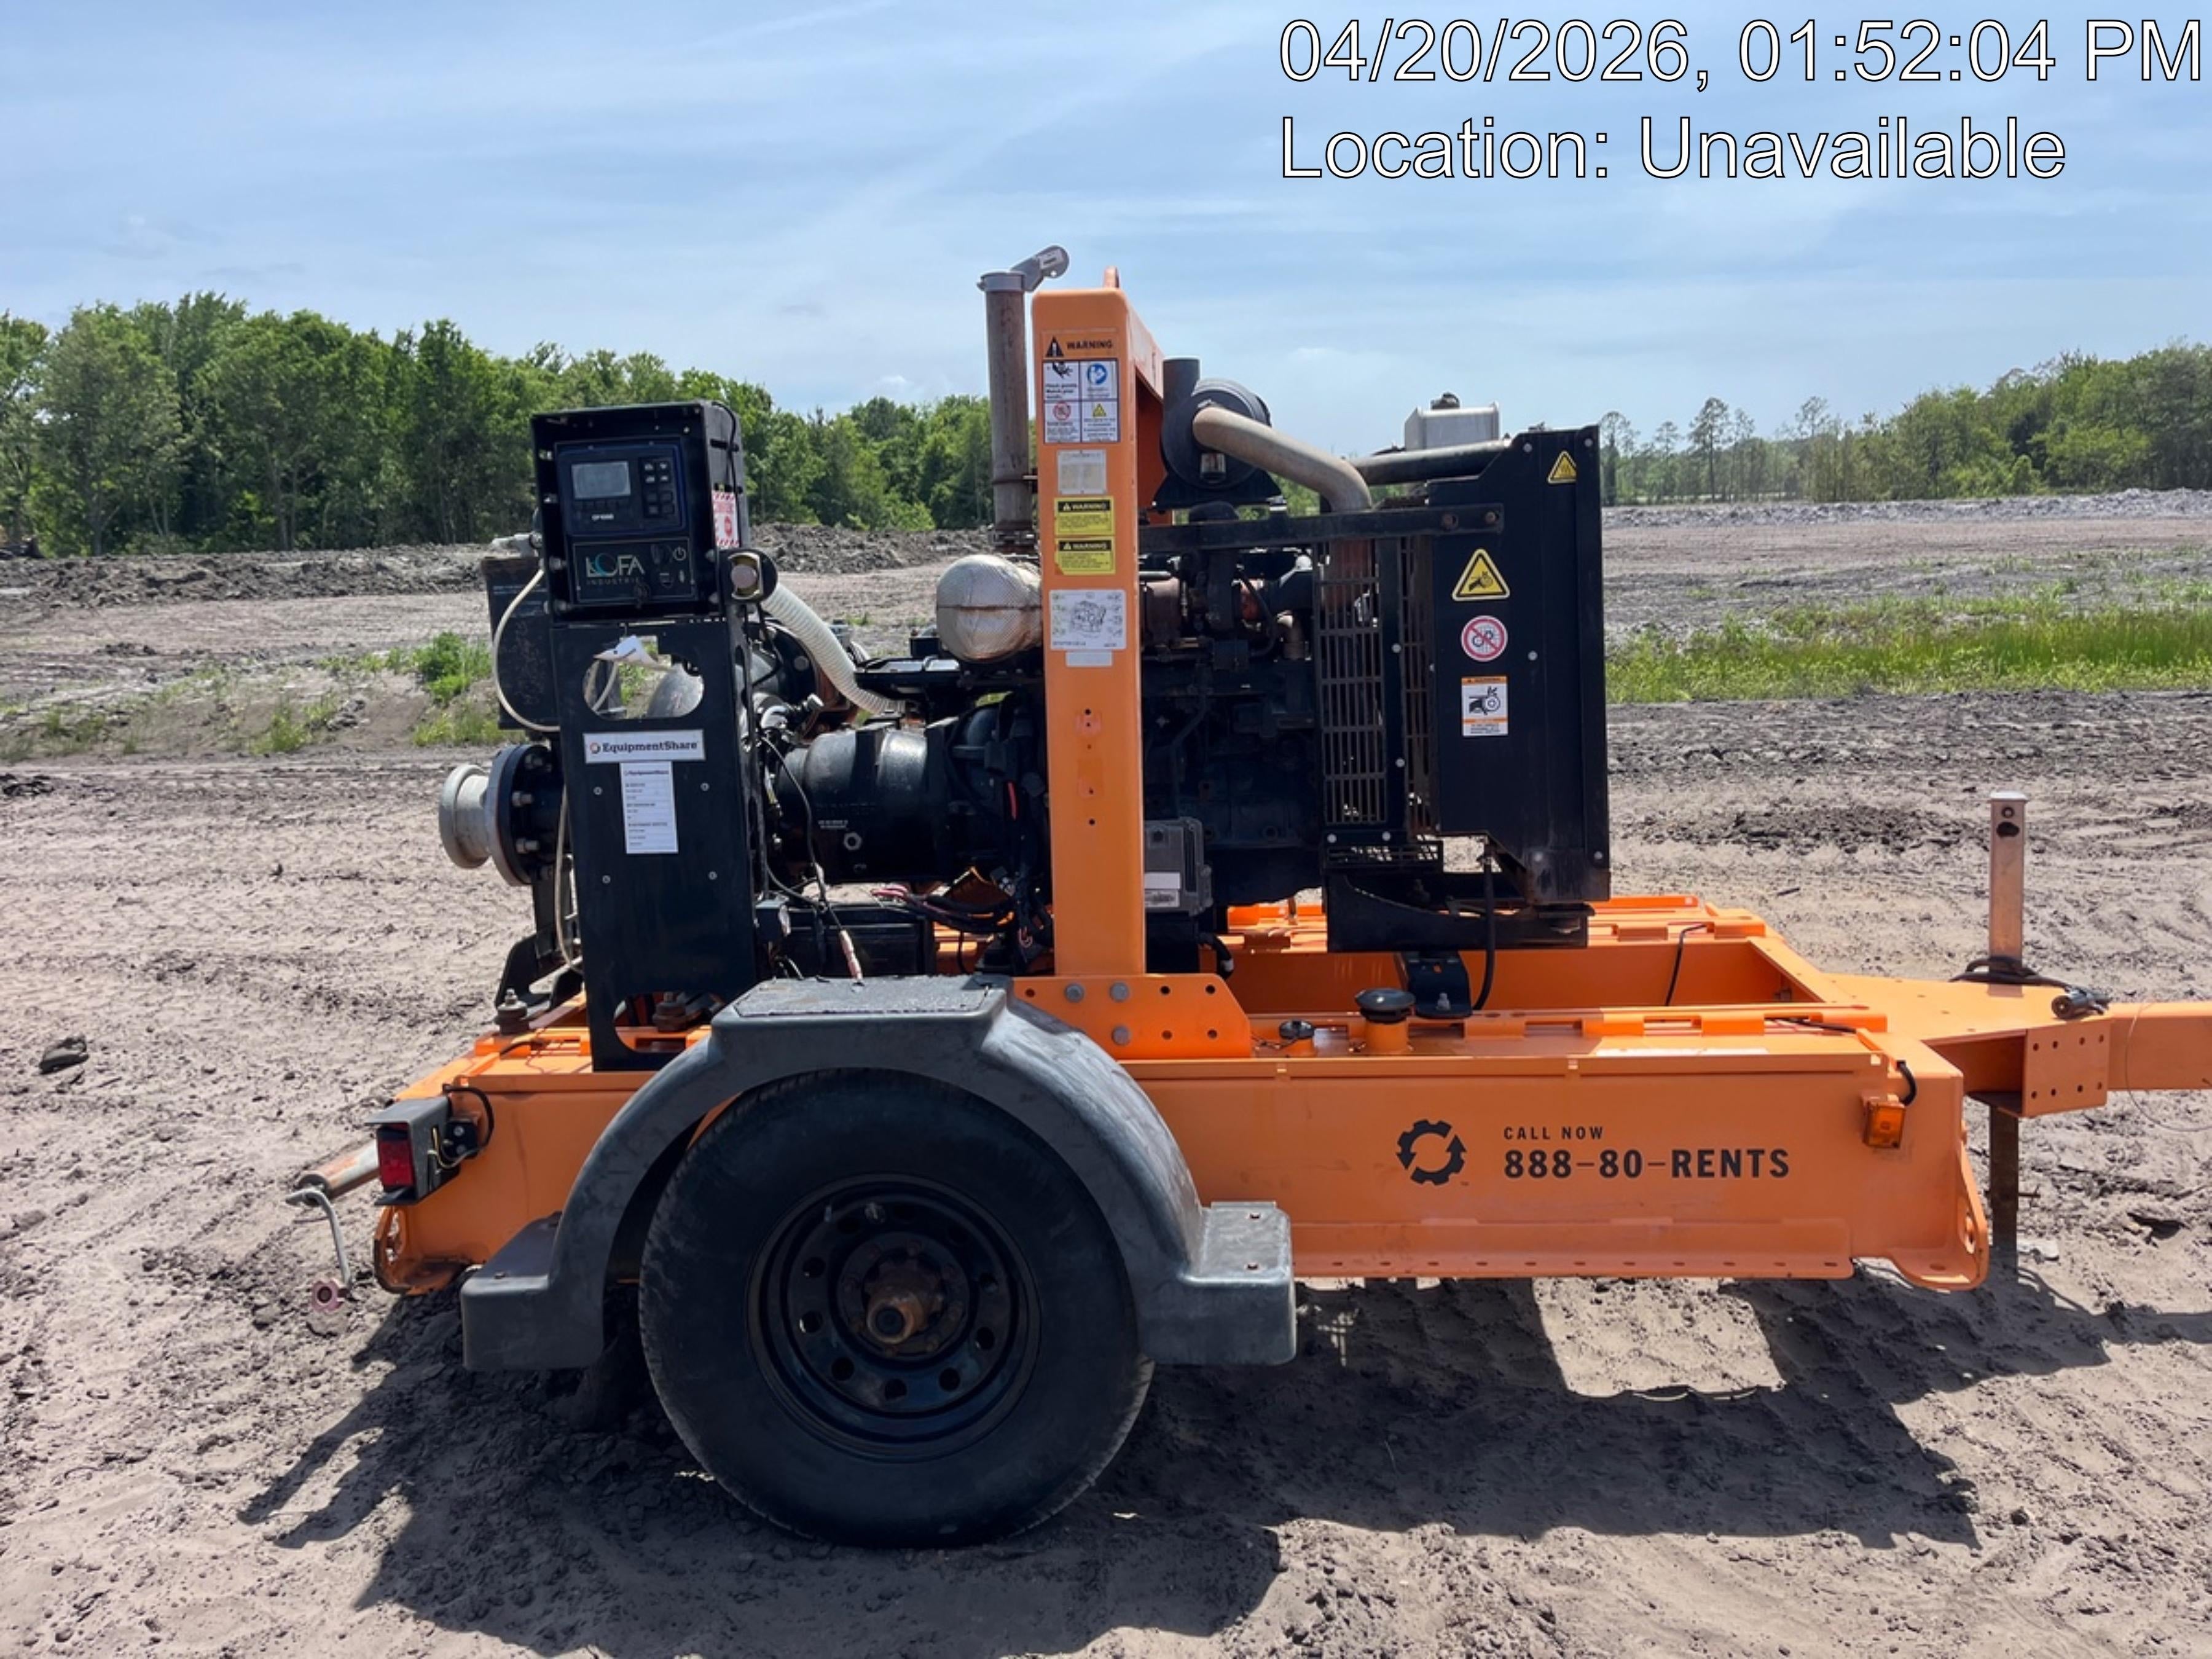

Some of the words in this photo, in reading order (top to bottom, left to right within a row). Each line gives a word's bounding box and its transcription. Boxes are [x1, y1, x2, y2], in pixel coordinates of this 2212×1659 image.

[1066, 339, 1113, 350] WARNING
[586, 553, 645, 578] LOFA
[602, 740, 698, 754] EquipmentShare
[1504, 1126, 1550, 1140] CALL
[1561, 1126, 1604, 1140] NOW
[1504, 1149, 1790, 1179] 888-80-RENTS
